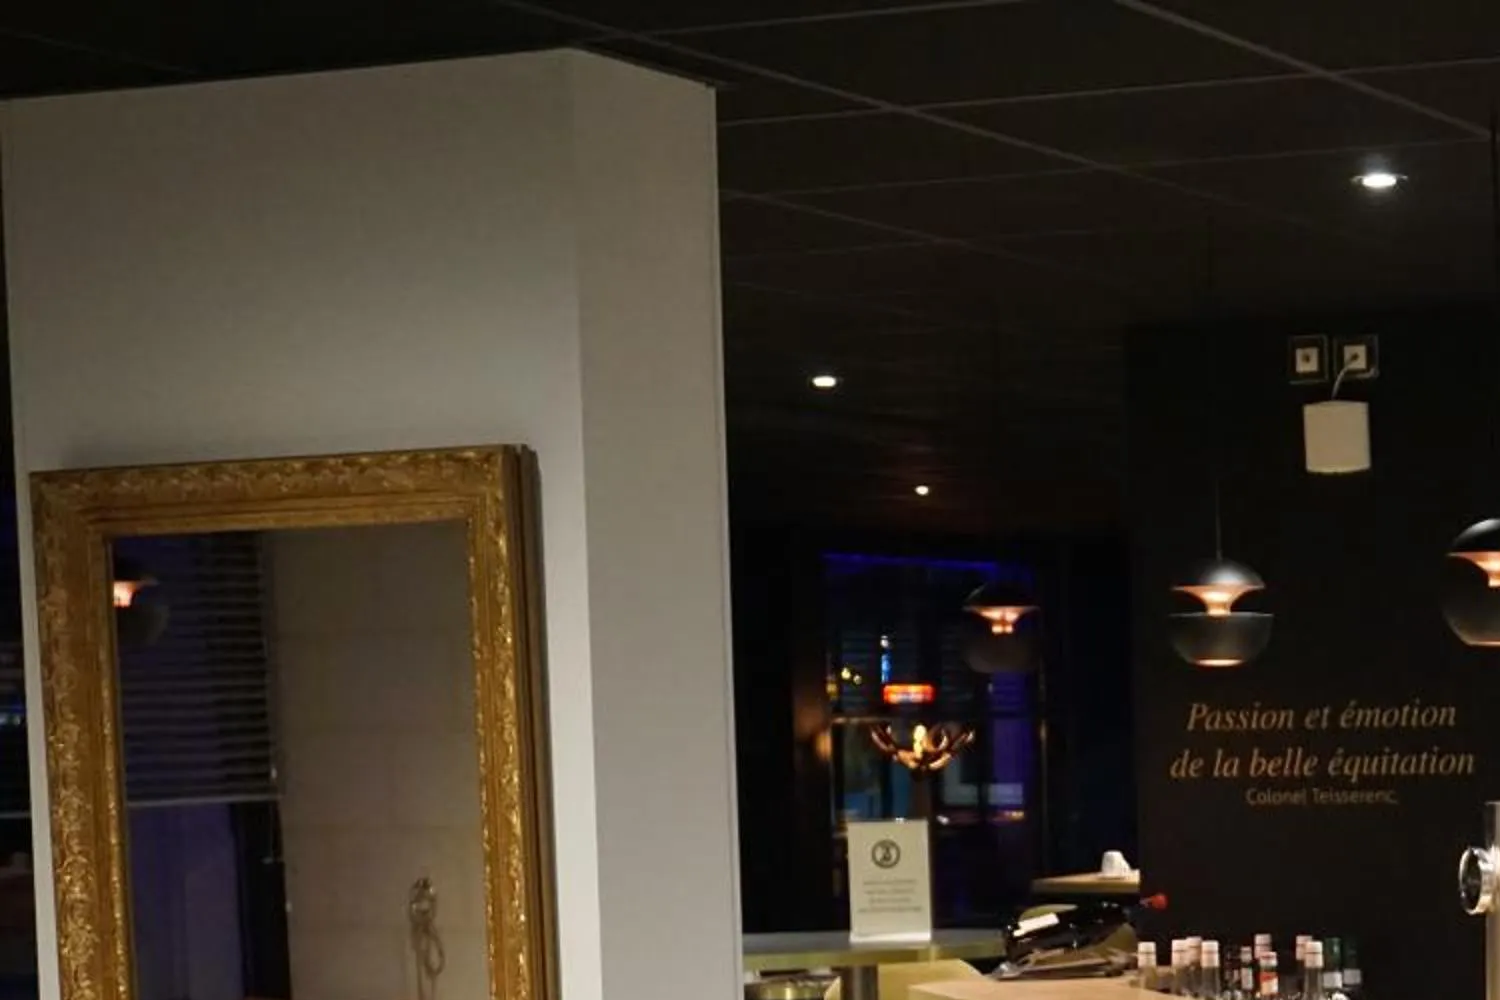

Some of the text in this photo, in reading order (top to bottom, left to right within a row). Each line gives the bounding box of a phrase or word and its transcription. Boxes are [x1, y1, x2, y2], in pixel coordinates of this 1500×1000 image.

[1187, 698, 1455, 731] Passion et émotion
[1170, 746, 1473, 784] de la belle équitation
[1246, 787, 1307, 805] Colonel
